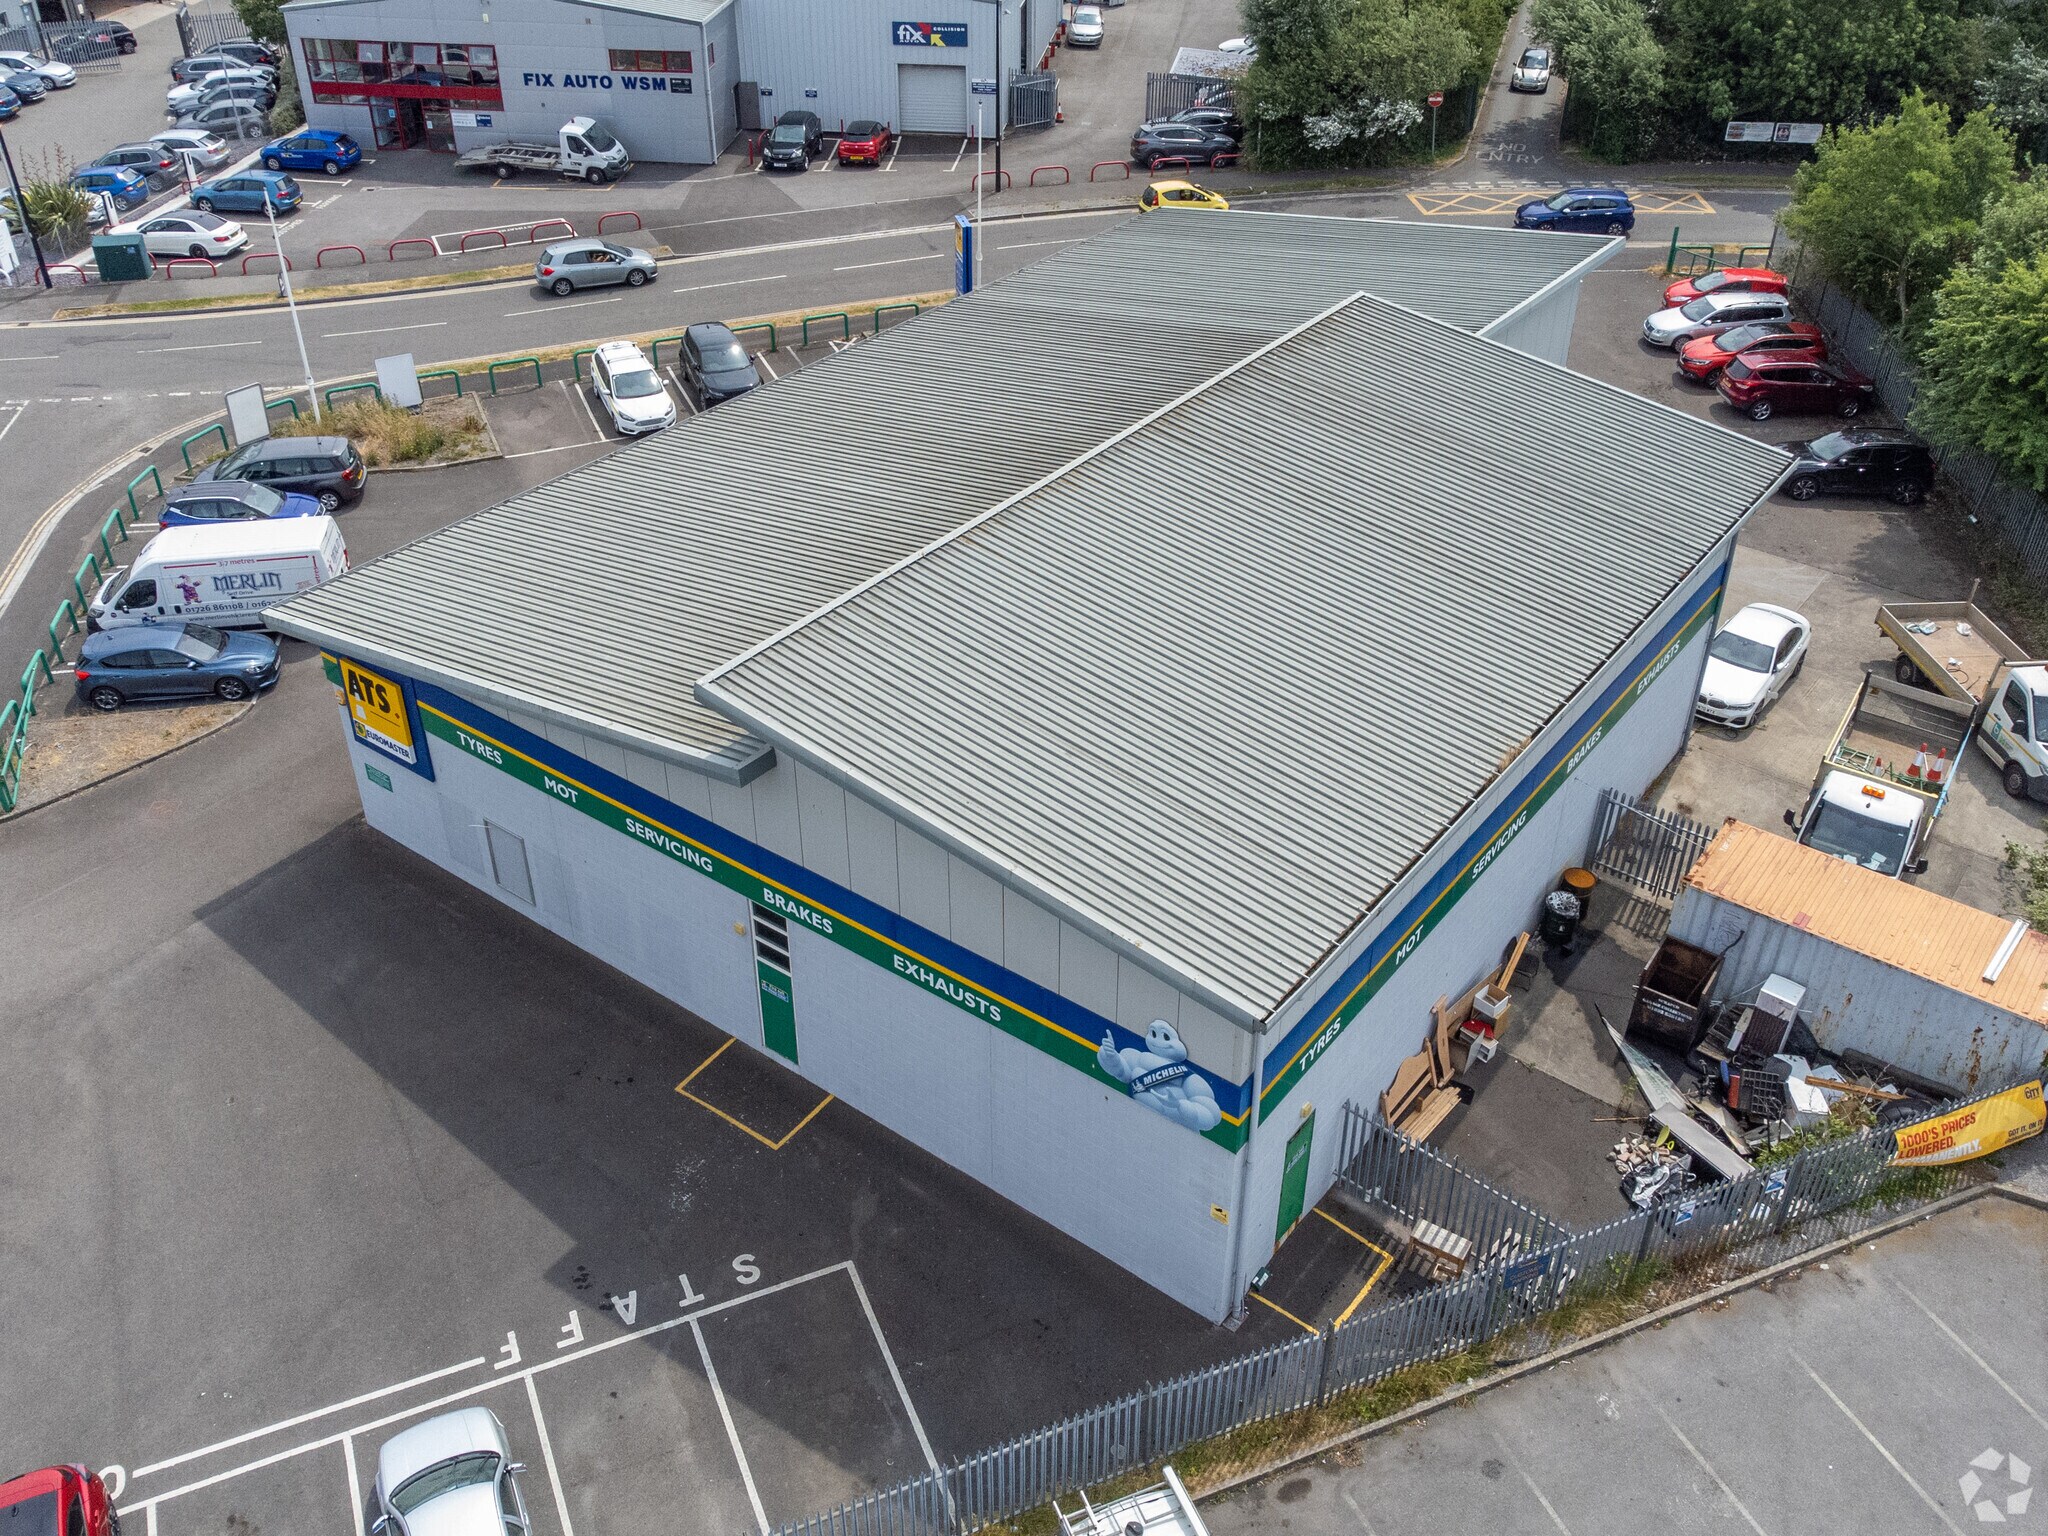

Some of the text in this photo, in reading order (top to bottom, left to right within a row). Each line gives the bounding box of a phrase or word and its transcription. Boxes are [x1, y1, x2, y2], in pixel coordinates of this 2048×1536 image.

[897, 24, 926, 43] fix
[523, 73, 554, 87] FIX
[563, 74, 613, 89] AUTO
[621, 76, 667, 91] WSM
[1475, 151, 1544, 164] ENTRY
[1498, 142, 1527, 152] NO
[212, 572, 281, 593] MERLIN
[185, 604, 211, 613] 01726
[213, 602, 244, 611] 861108
[1636, 639, 1681, 696] EXHAUSTS
[347, 668, 392, 714] ATS
[366, 729, 411, 760] EUROMASTER
[457, 730, 503, 765] TYRES
[1566, 726, 1602, 775] BRAKES
[544, 775, 579, 804] MOT
[625, 817, 713, 873] SERVICING
[1471, 810, 1527, 880] SERVICING
[763, 887, 833, 935] BRAKES
[1395, 924, 1424, 966] MOT
[893, 954, 1002, 1022] EXHAUSTS
[1299, 1016, 1341, 1072] TYRES
[1143, 1064, 1188, 1085] MICHELIN
[2024, 1086, 2040, 1099] CITY
[1901, 1111, 1976, 1148] 1000'S PRICES
[1898, 1135, 1956, 1160] LOWERED.
[494, 1252, 761, 1371] STAFF
